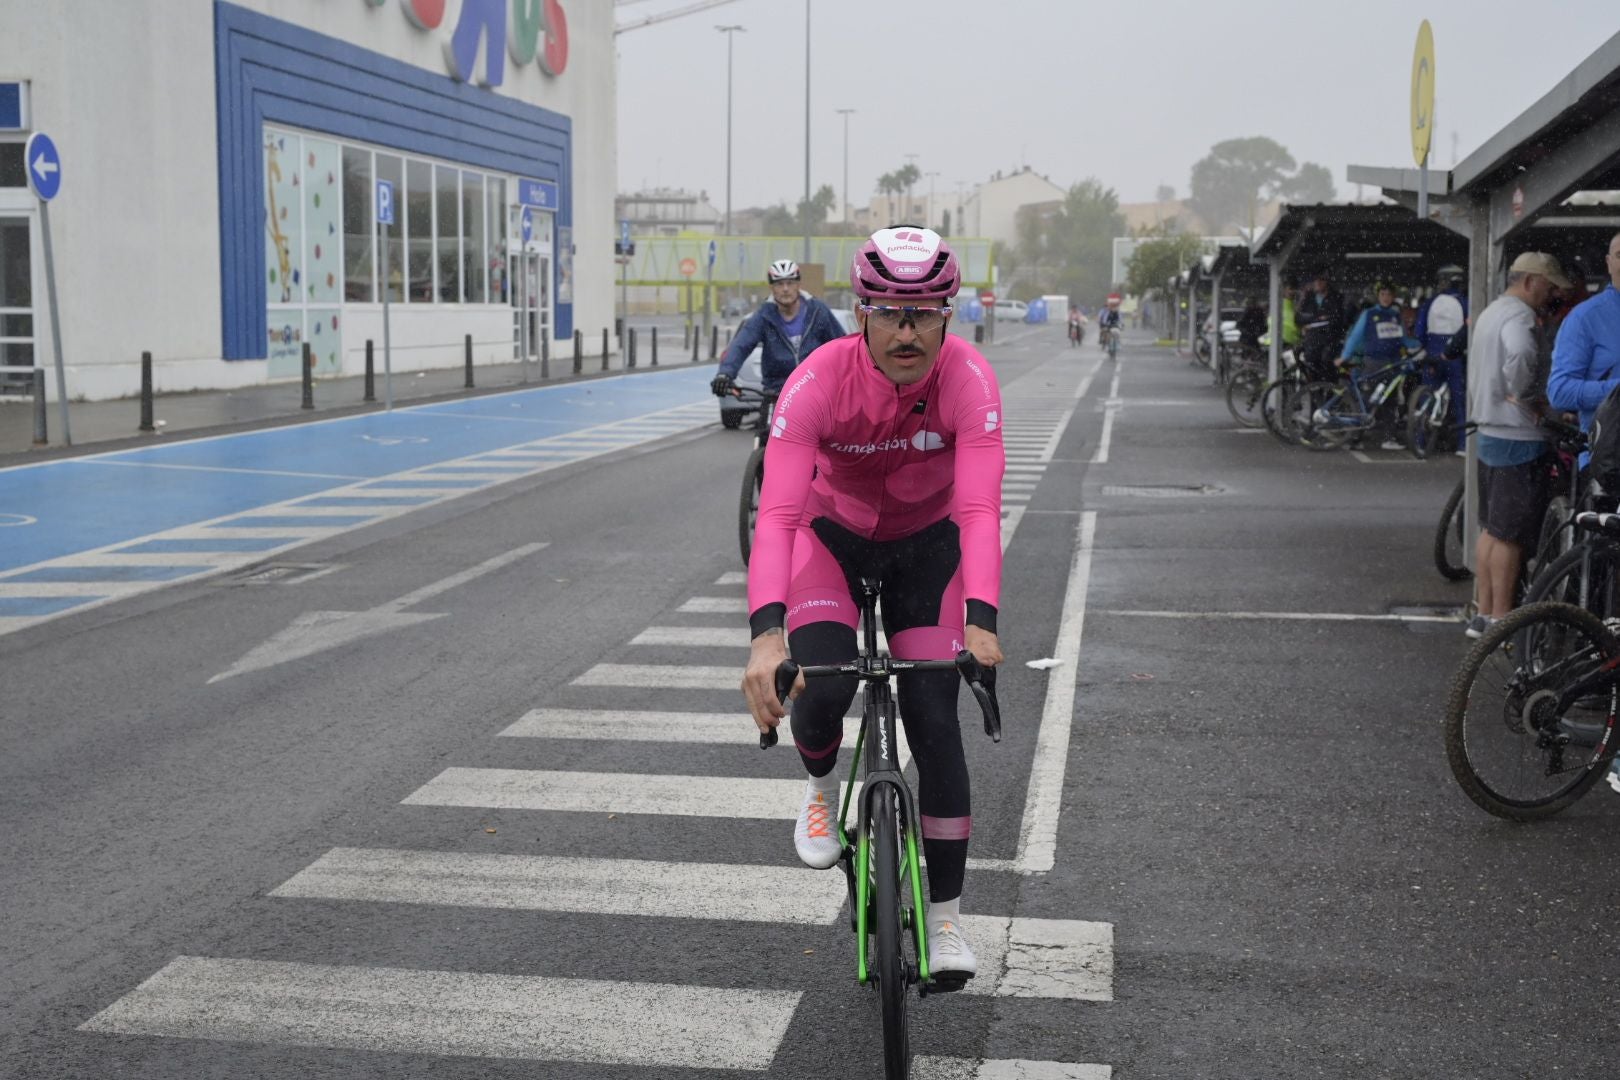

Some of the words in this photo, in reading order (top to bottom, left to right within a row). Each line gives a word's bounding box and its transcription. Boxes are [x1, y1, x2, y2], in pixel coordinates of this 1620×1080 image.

[379, 185, 390, 218] P
[887, 245, 931, 255] fundación
[778, 369, 815, 414] fundación
[952, 639, 965, 652] fu
